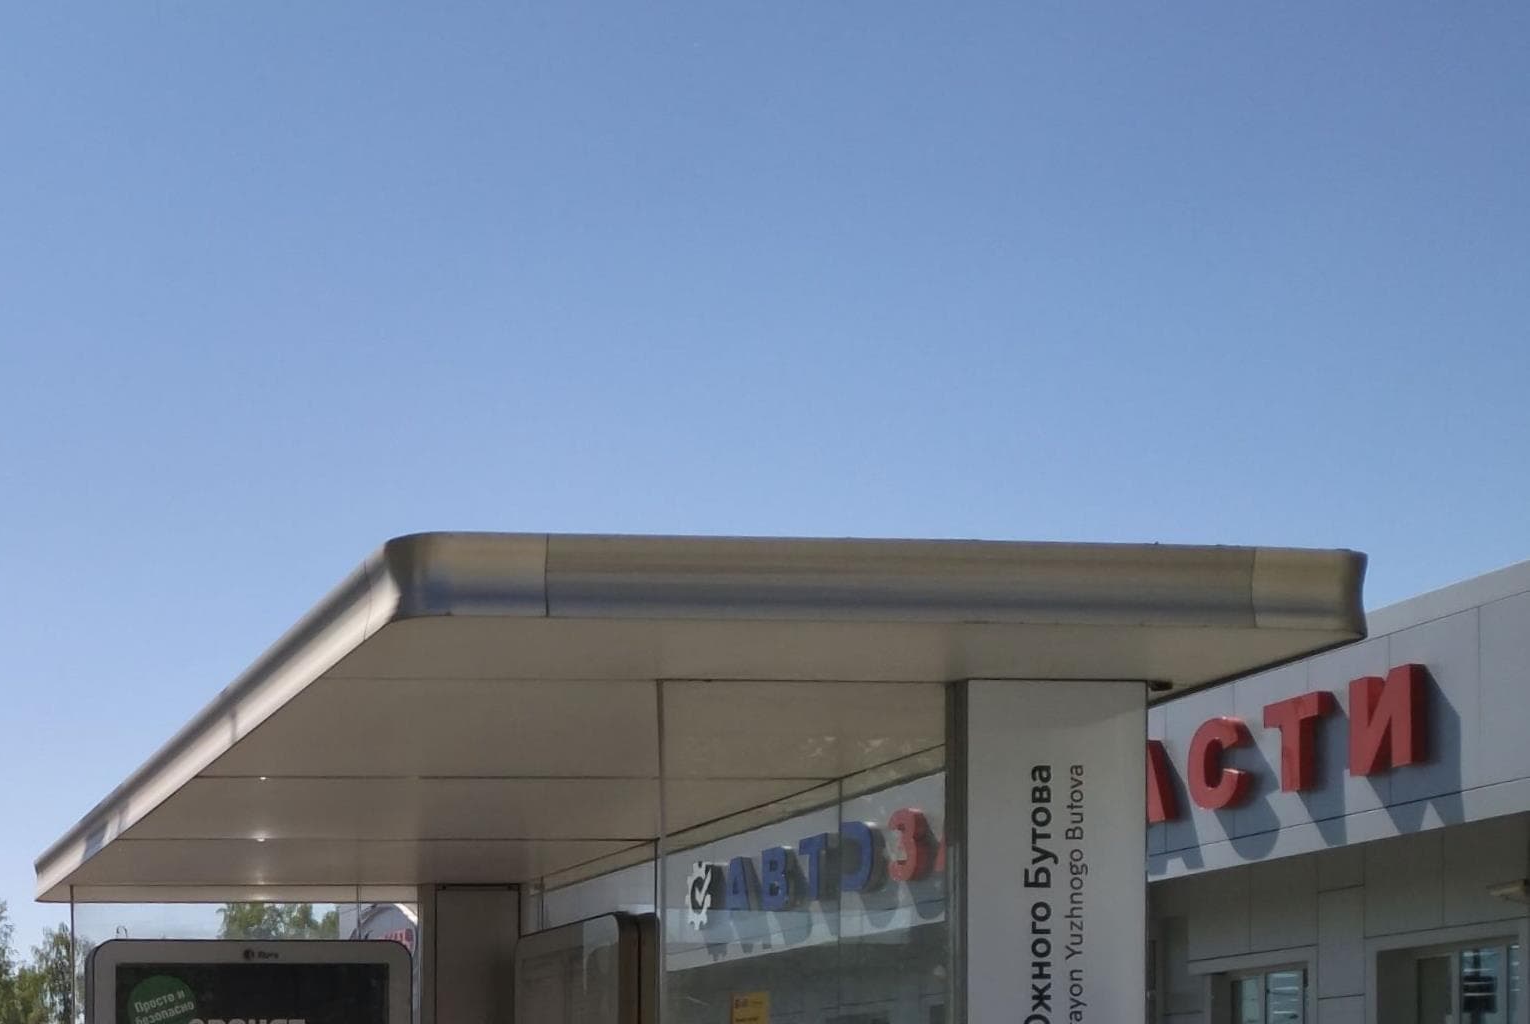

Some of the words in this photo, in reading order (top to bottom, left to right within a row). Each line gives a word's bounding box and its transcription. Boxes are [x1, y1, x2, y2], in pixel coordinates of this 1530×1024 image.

[1024, 764, 1059, 889] Бутова
[1065, 764, 1085, 840] Butova
[726, 808, 945, 910] АВТОЗ
[1065, 849, 1089, 960] Yuzhnogo
[134, 993, 175, 1013] Просто
